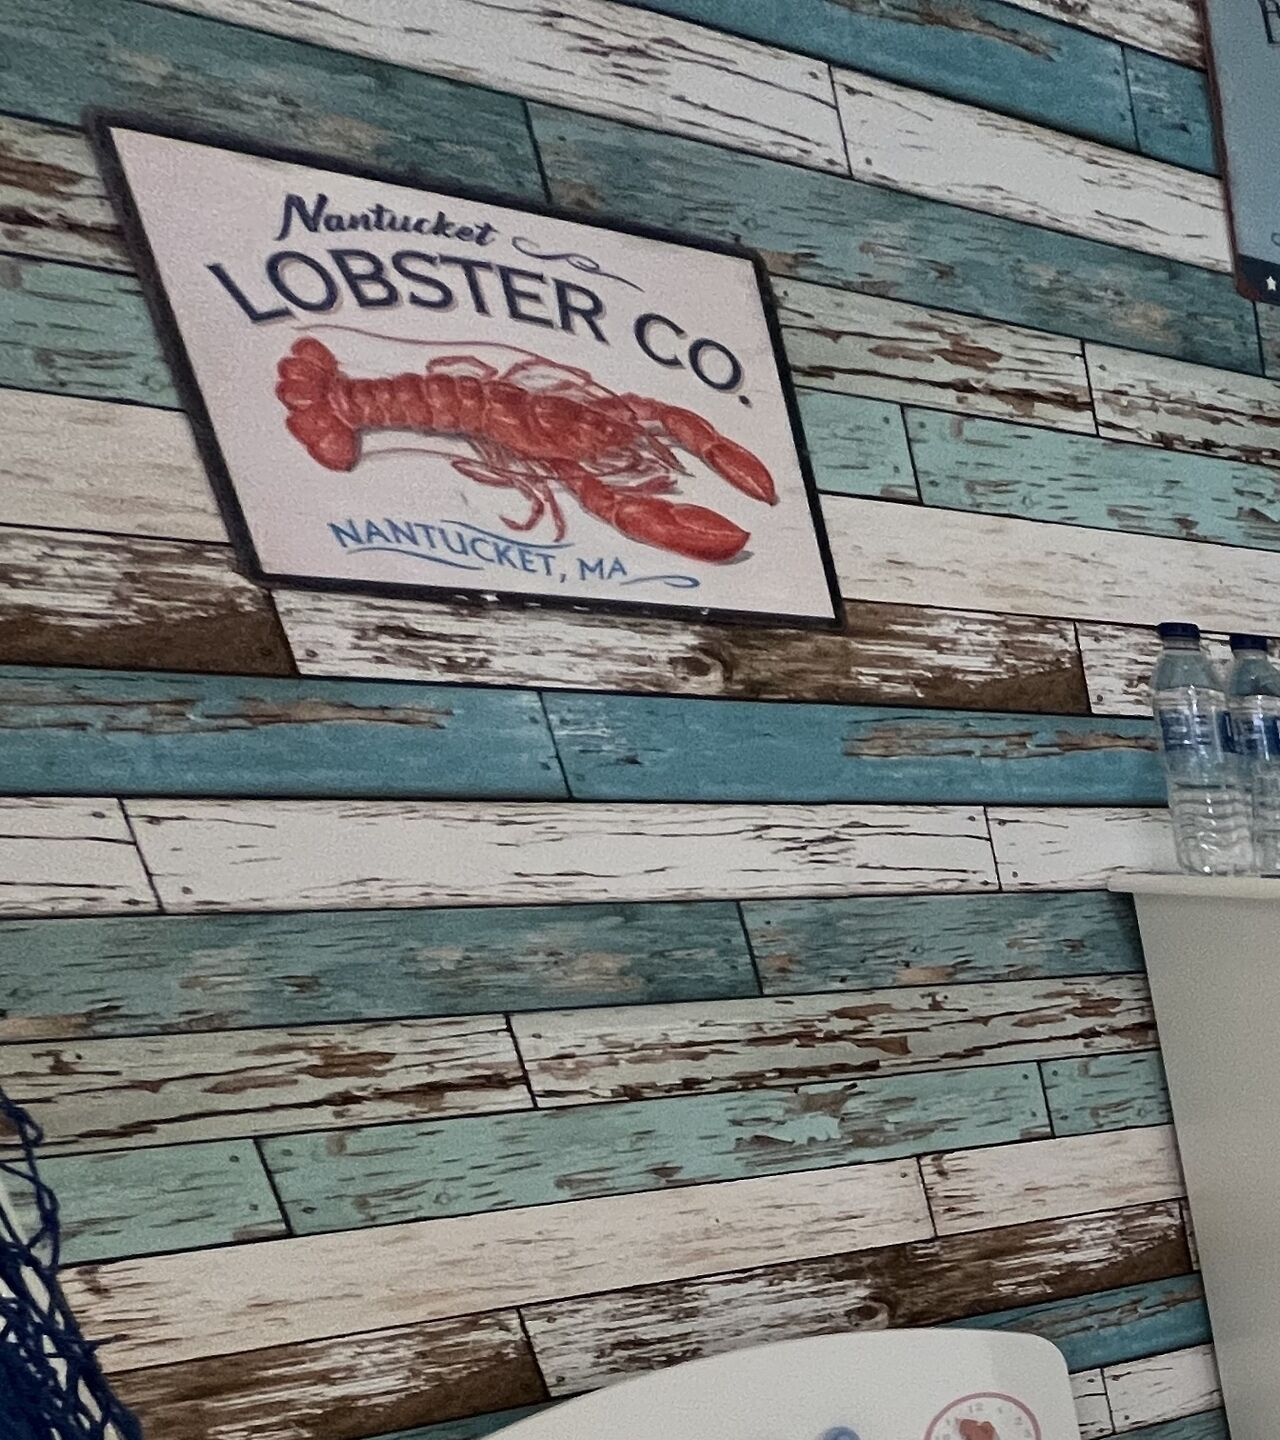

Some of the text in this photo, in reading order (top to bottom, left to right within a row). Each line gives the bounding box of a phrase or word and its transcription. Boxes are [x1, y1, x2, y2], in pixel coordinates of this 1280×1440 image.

[273, 192, 498, 246] Nantucket
[203, 247, 752, 408] LOBSTER CO.
[327, 517, 627, 583] NANTUCKET, MA
